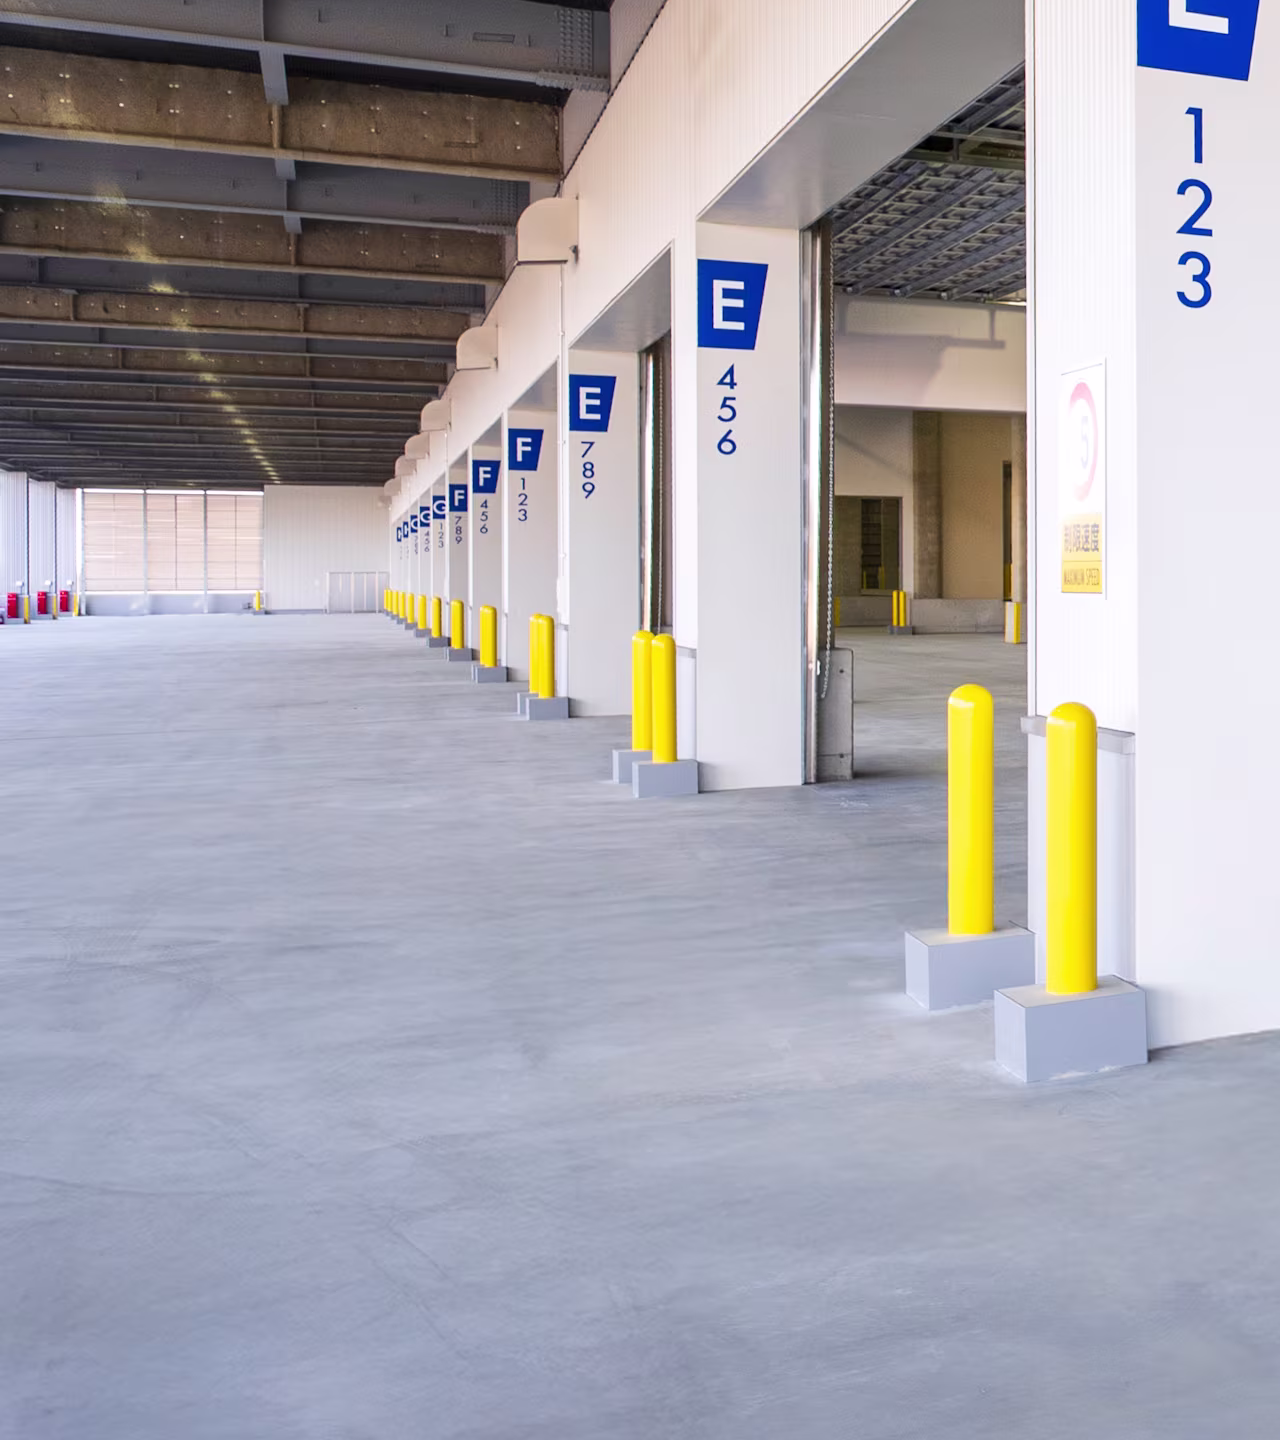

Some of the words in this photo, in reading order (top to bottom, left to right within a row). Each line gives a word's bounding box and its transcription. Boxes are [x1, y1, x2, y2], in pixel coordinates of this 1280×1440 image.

[1185, 107, 1203, 164] 1
[1176, 178, 1213, 237] 2
[1176, 251, 1212, 309] 3
[713, 279, 745, 331] E
[716, 363, 738, 390] 4
[579, 386, 602, 420] E
[717, 396, 737, 423] 5
[516, 437, 532, 462] F
[581, 440, 596, 459] 7
[717, 428, 737, 456] 6
[479, 466, 491, 486] F
[582, 461, 595, 479] 8
[454, 490, 464, 506] F
[582, 481, 596, 499] 9
[433, 500, 445, 514] G
